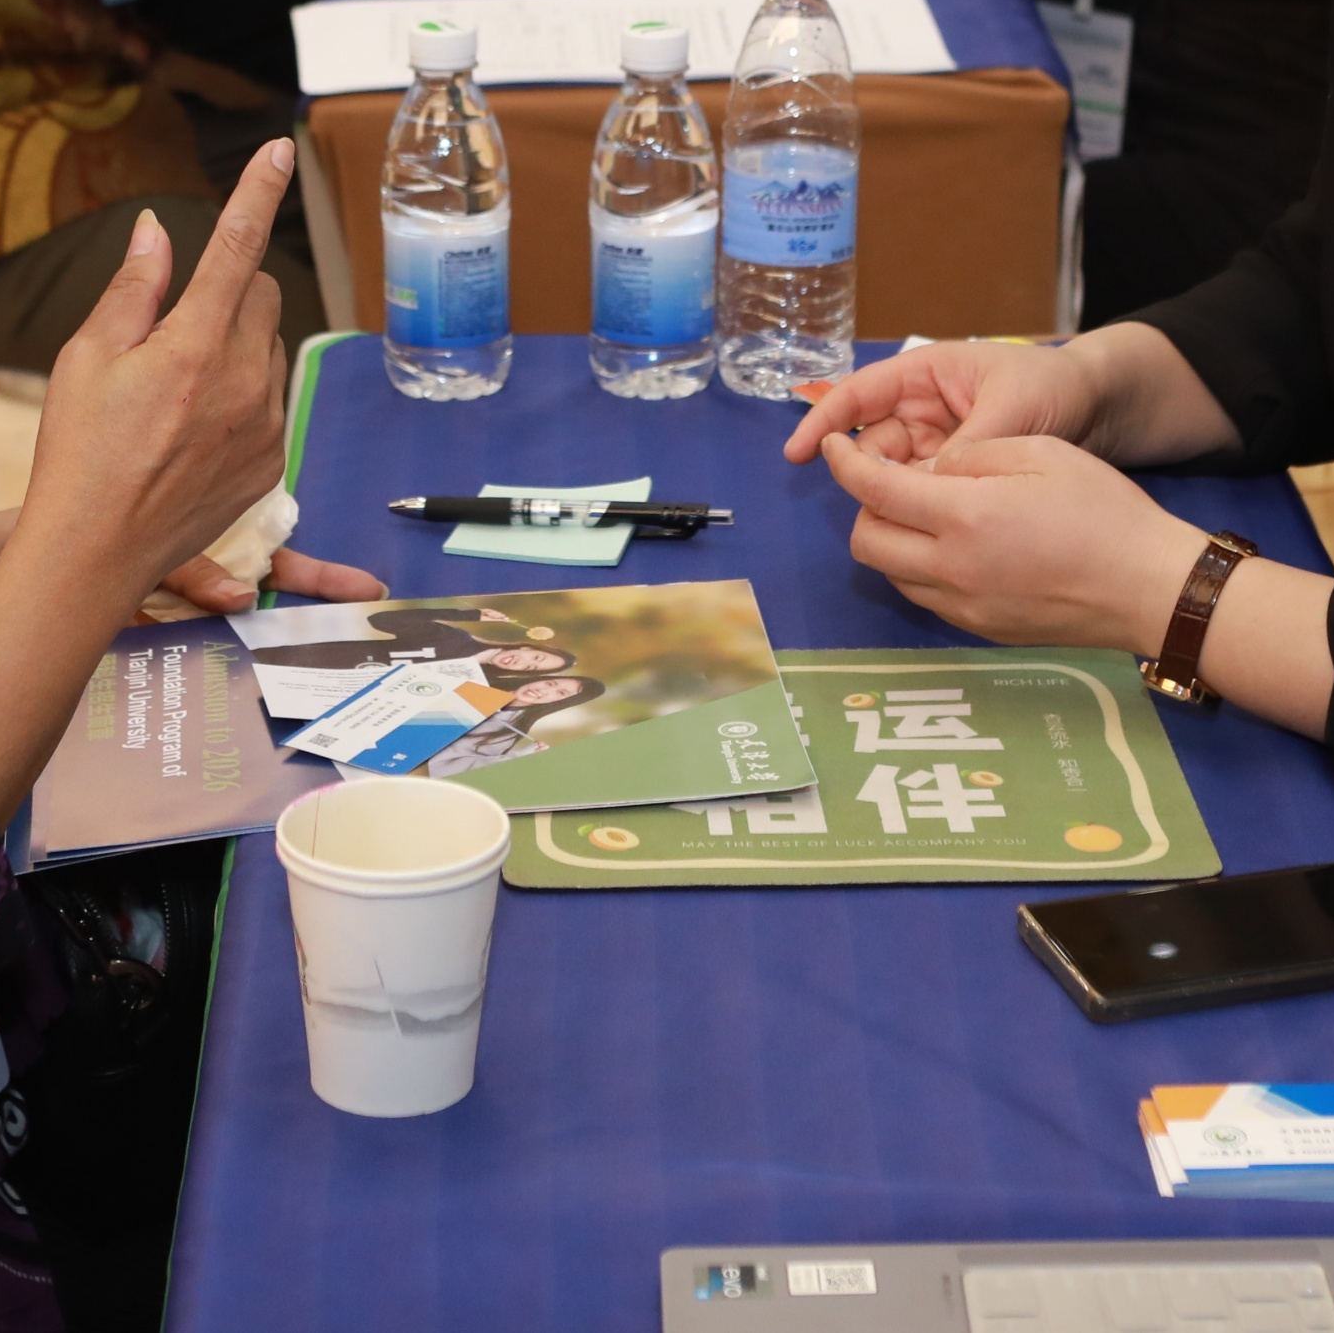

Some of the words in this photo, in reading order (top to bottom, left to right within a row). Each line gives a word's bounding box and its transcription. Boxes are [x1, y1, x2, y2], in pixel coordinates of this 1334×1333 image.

[124, 648, 153, 689] Tianjin
[162, 645, 187, 708] Foundation
[202, 641, 241, 723] Admission
[993, 679, 1033, 687] RICH
[1038, 678, 1070, 687] LIFE
[122, 690, 152, 750] University
[158, 710, 187, 764] Program
[203, 727, 235, 744] to
[162, 762, 187, 778] of
[202, 747, 242, 792] 2026
[681, 841, 718, 849] MAY
[725, 840, 755, 849] THE
[761, 840, 802, 848] BEST
[808, 840, 829, 848] OF
[835, 839, 877, 848] LUCK
[883, 838, 989, 848] ACCOMPANY
[993, 837, 1028, 846] YOU
